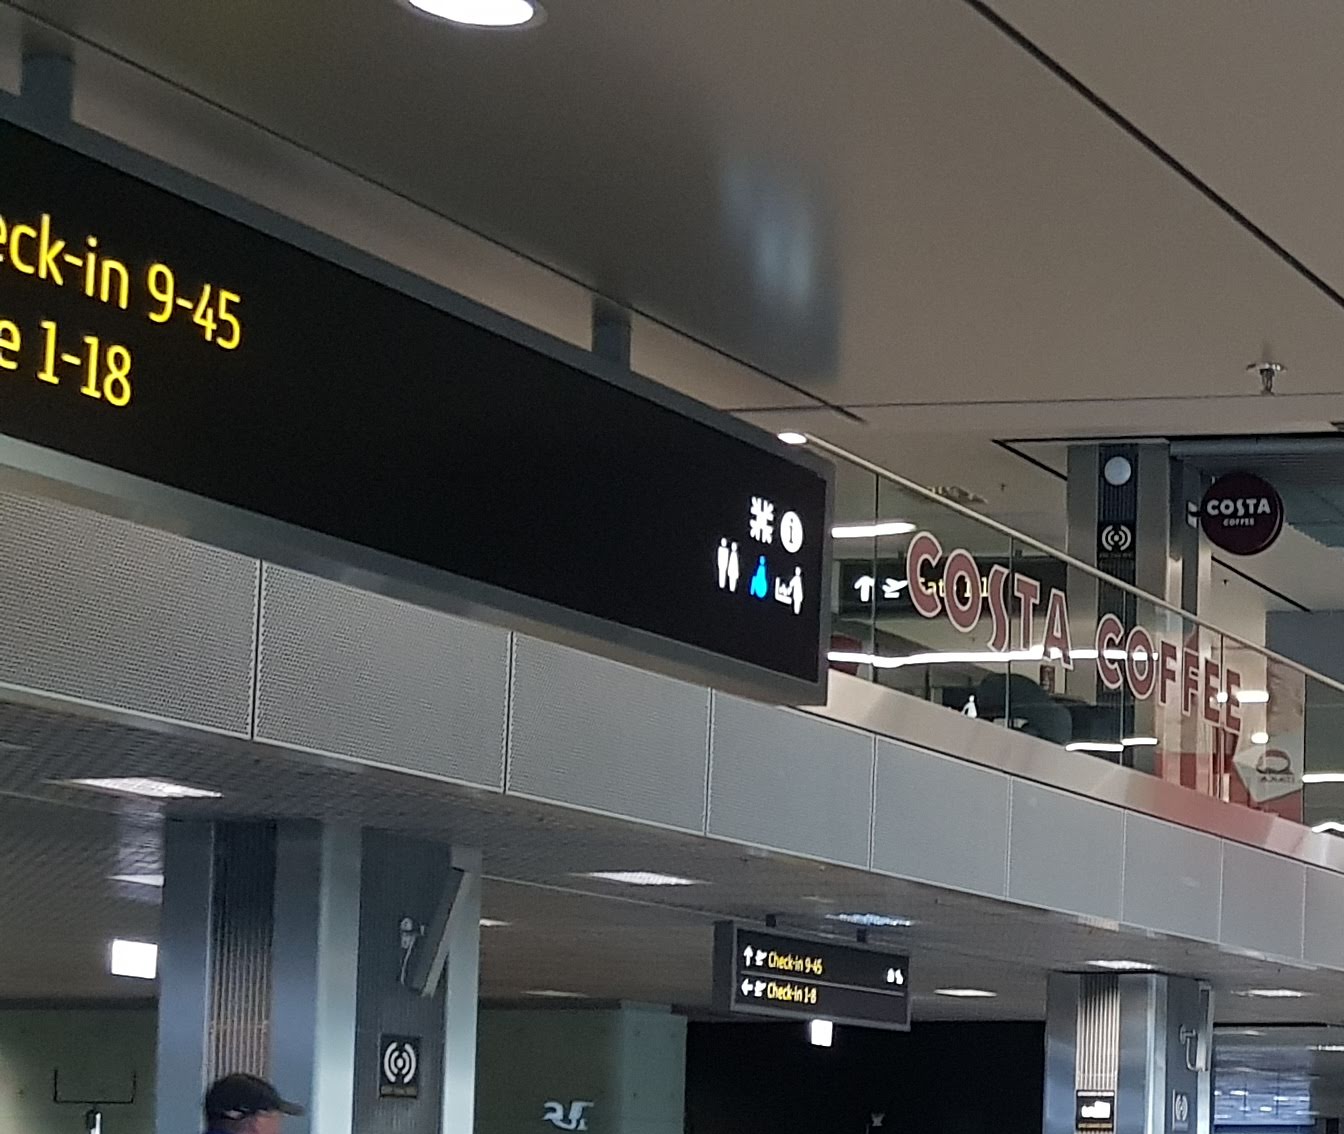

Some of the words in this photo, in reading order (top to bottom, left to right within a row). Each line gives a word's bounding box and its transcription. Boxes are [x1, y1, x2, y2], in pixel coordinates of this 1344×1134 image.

[148, 263, 241, 350] 9-45
[37, 320, 131, 407] 1-18
[1206, 497, 1271, 516] COSTA
[1222, 517, 1255, 527] COFFEE
[907, 531, 1074, 670] COSTA
[1095, 612, 1243, 734] COFFEE
[768, 950, 804, 972] Check-in
[767, 980, 803, 1003] Check-in
[804, 985, 817, 1004] 1-8
